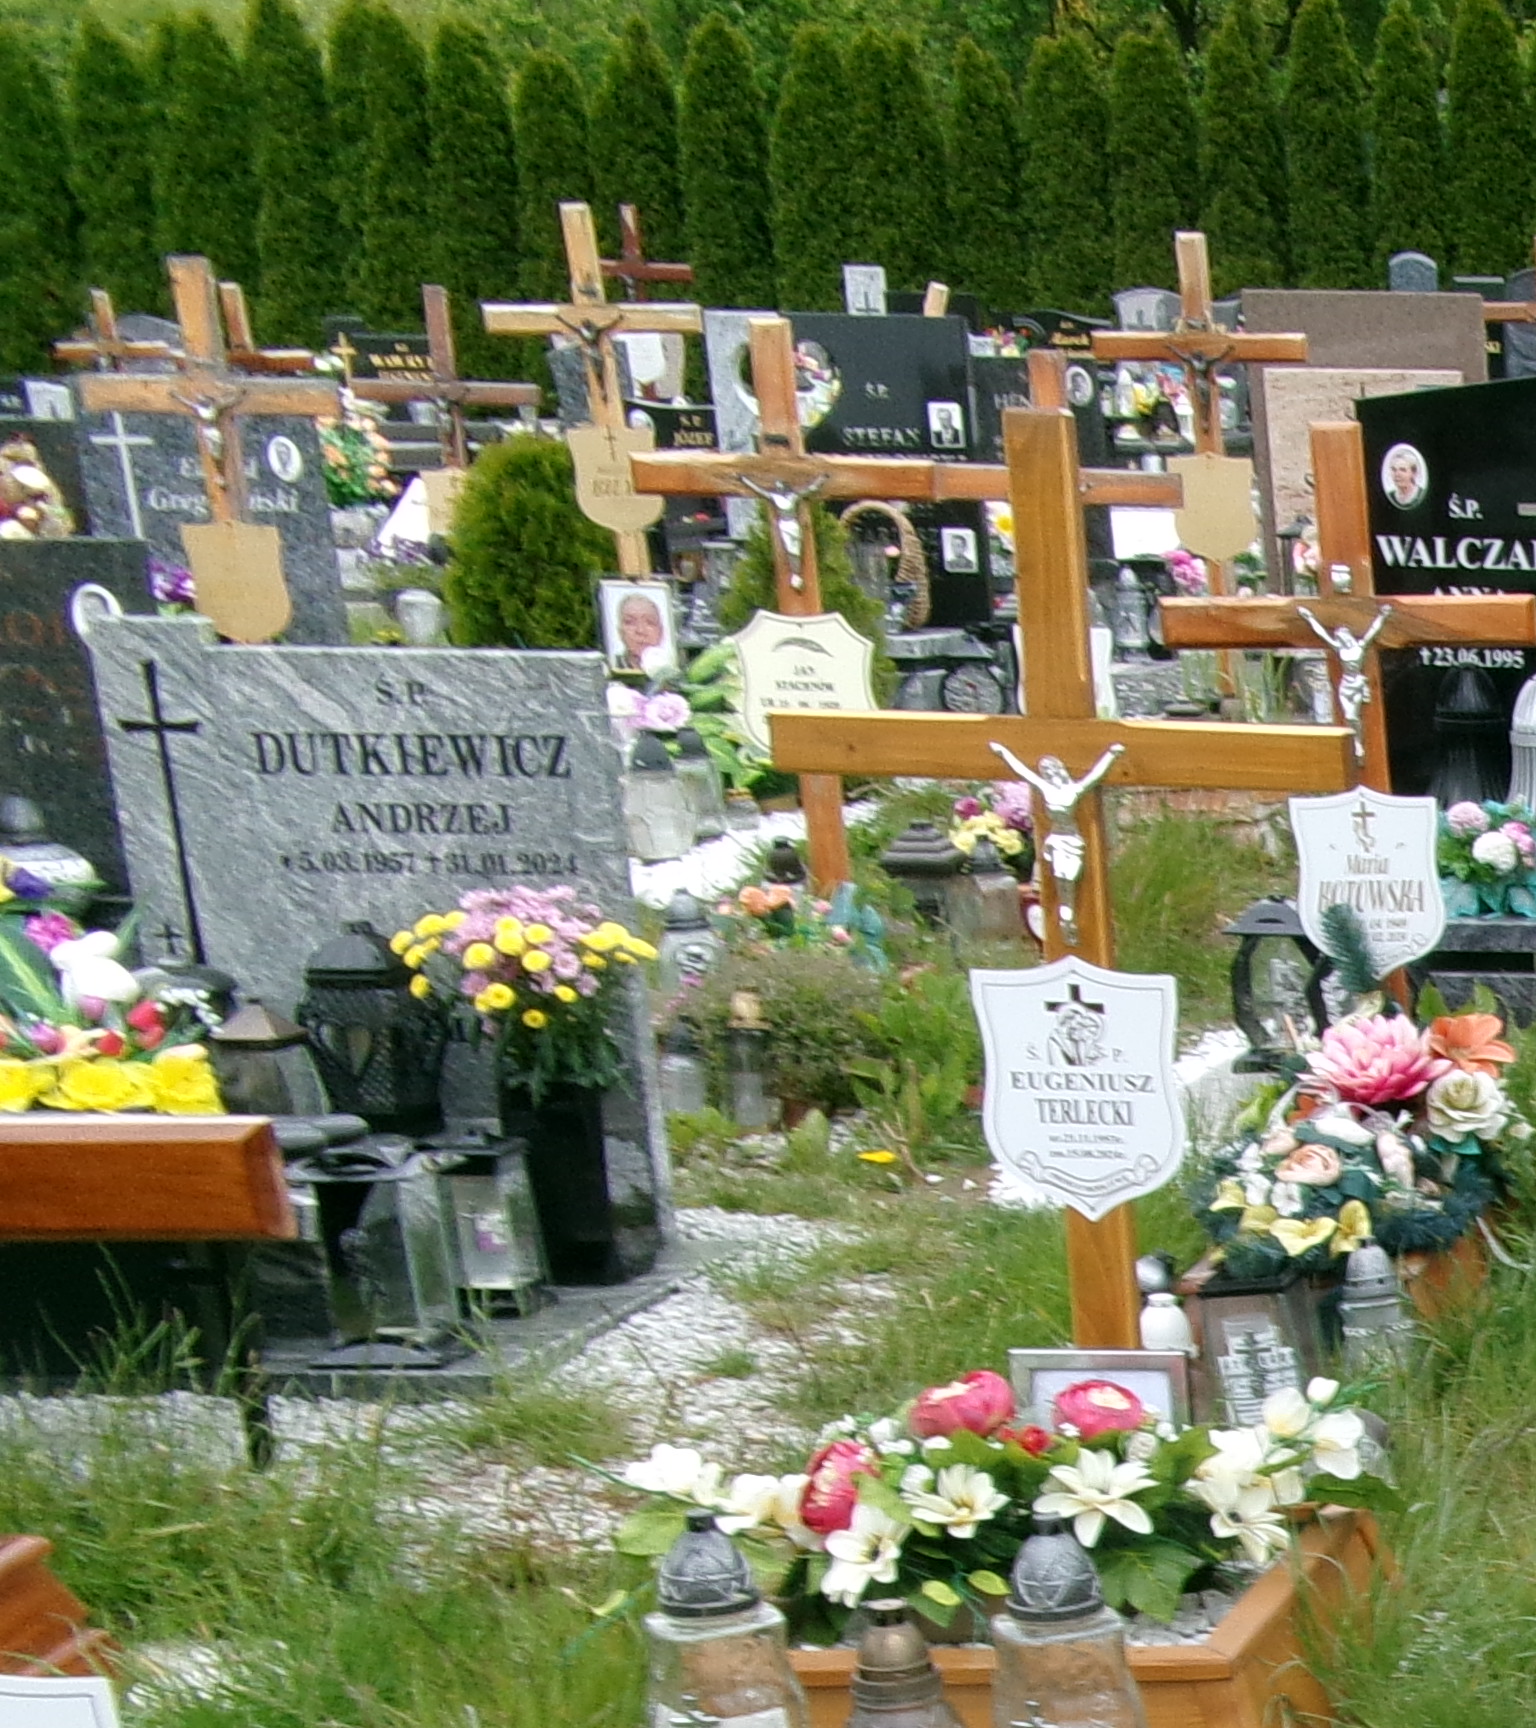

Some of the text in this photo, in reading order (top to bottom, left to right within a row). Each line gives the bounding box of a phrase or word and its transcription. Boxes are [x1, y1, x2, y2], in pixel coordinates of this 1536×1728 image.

[1448, 493, 1484, 520] Ś.P.
[253, 730, 572, 780] DUTKIEWICZ
[331, 802, 513, 836] ANDRZEJ
[1010, 1070, 1156, 1094] EUGENIUSZ
[1035, 1097, 1136, 1127] TERLECKI
